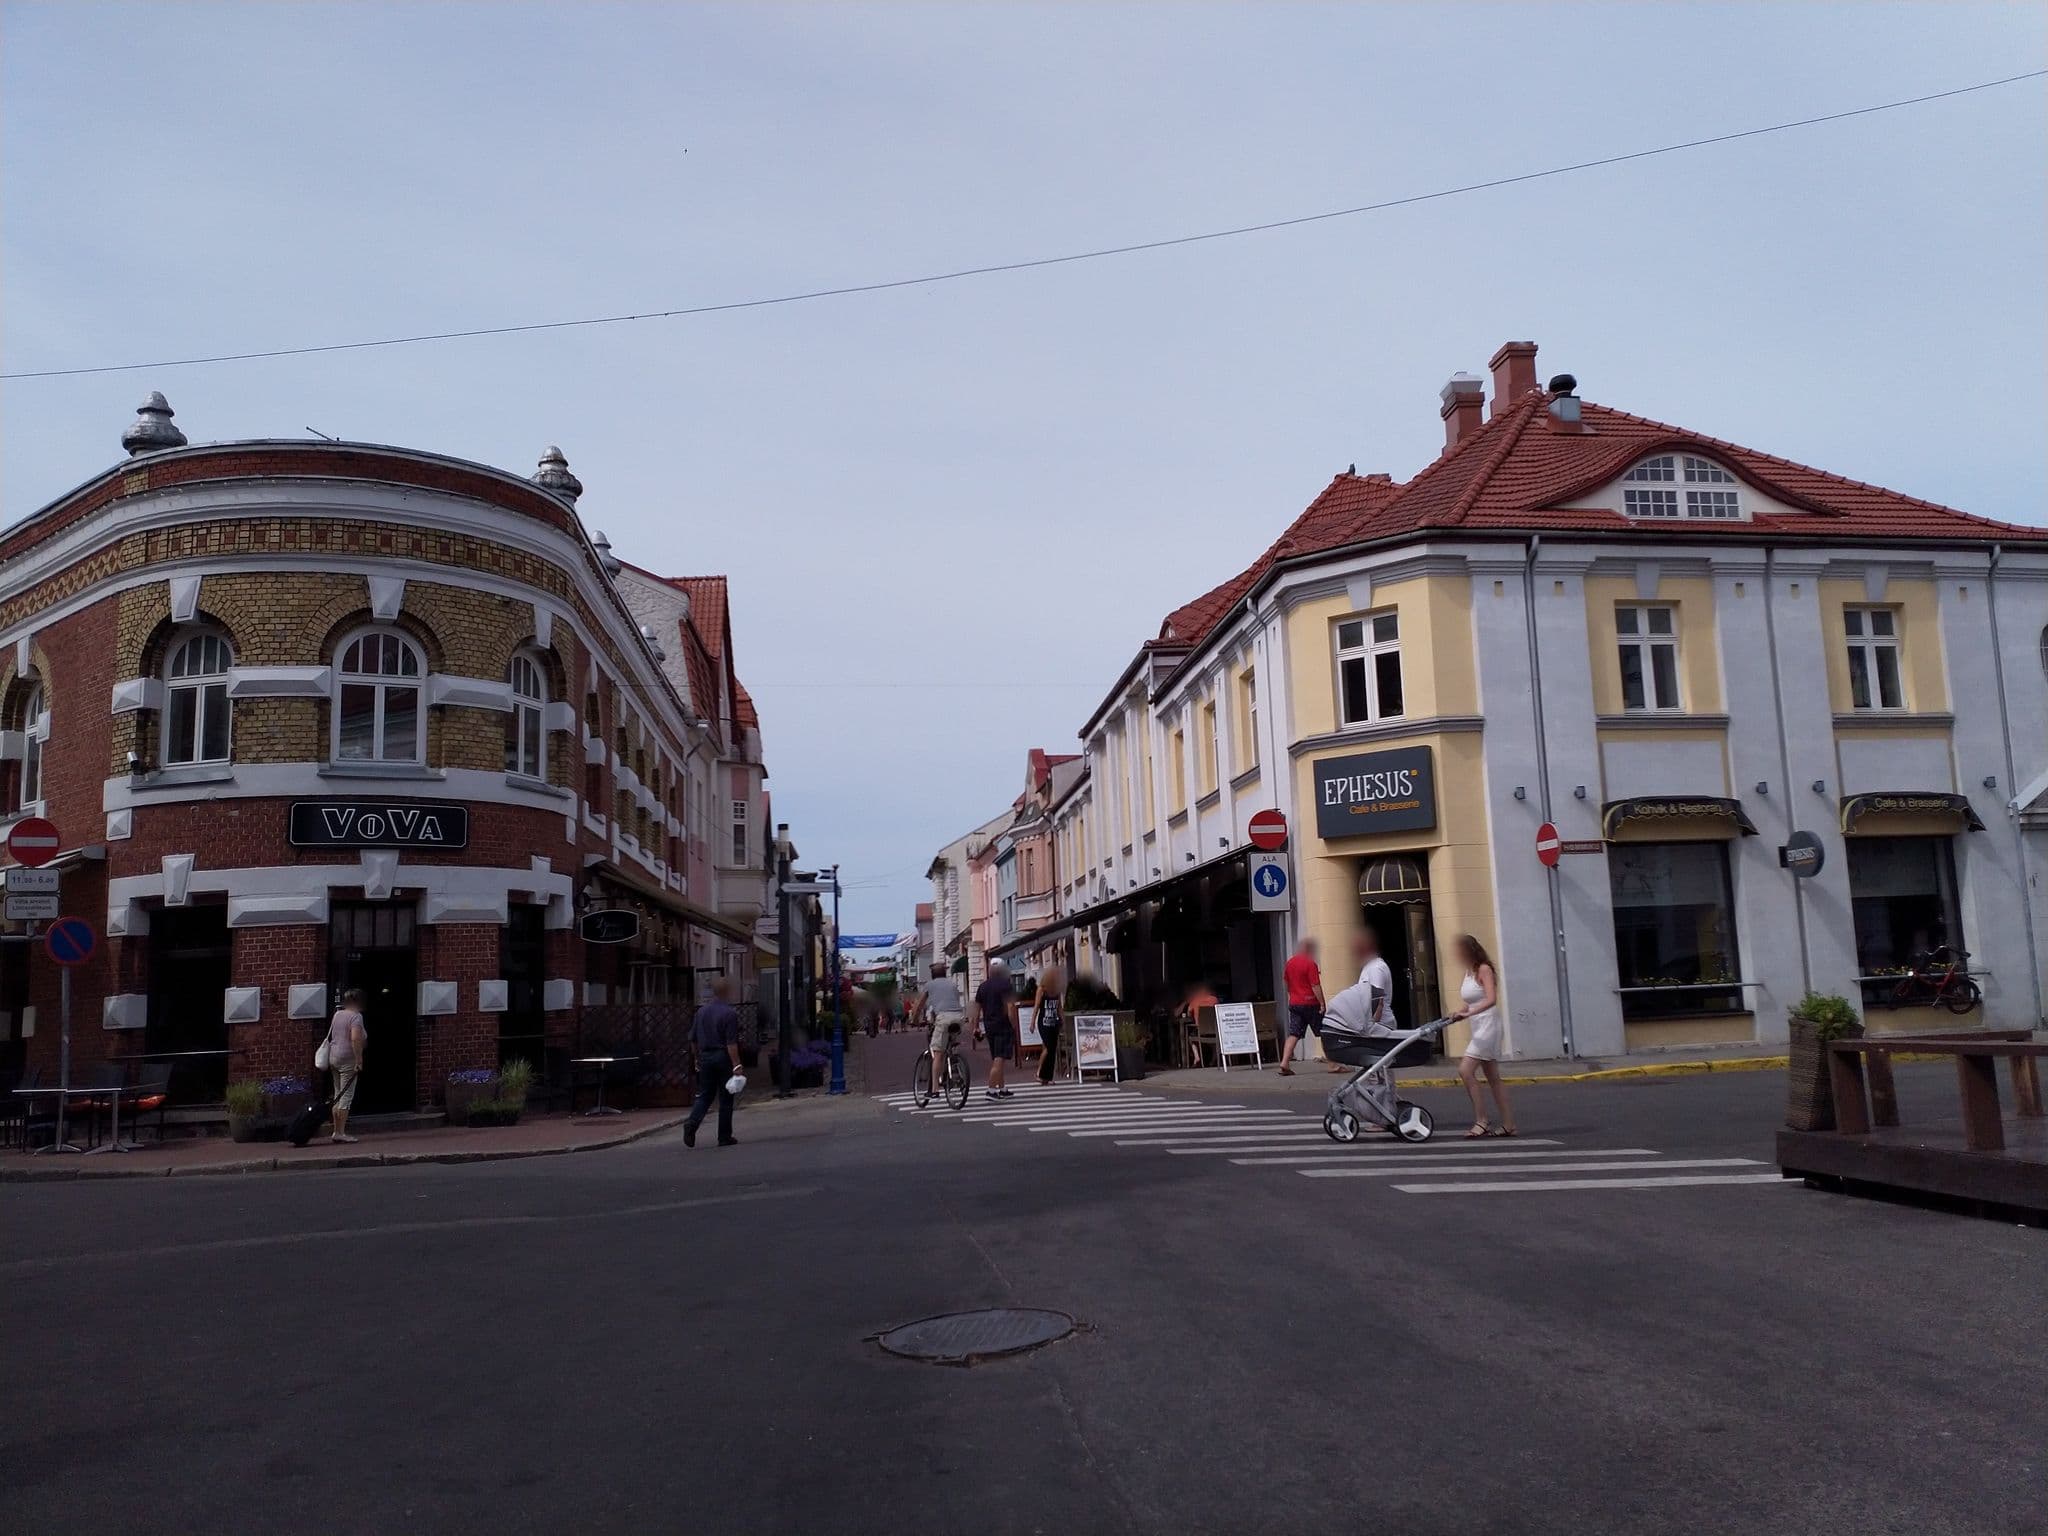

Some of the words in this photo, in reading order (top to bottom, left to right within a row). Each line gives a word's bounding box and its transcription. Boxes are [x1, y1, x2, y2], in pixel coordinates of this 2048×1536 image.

[1324, 769, 1413, 806] EPHESUS
[1370, 803, 1379, 813] &
[1380, 800, 1420, 812] Brasserie
[1899, 798, 1906, 808] &
[1908, 797, 1950, 808] Brasserie
[1633, 804, 1668, 815] Kohvik
[1669, 804, 1678, 814] &
[1678, 803, 1723, 814] Restoran
